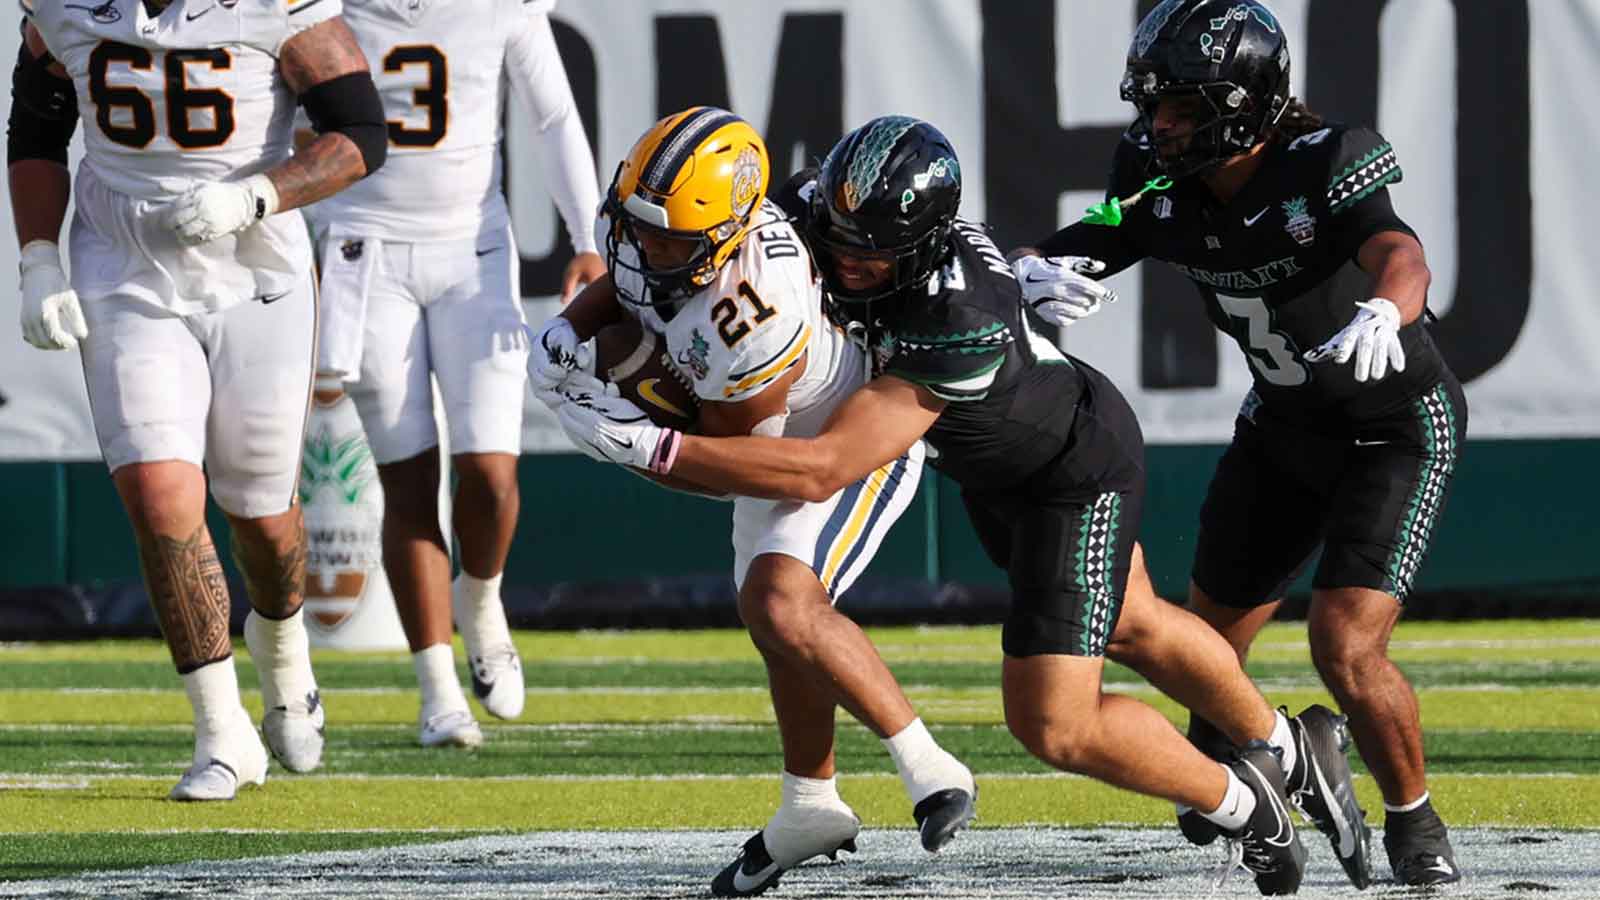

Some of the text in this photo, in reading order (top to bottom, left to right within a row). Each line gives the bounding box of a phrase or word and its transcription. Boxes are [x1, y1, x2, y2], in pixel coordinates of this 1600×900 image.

[88, 40, 235, 150] 66
[383, 44, 449, 148] 3
[710, 280, 777, 349] 21
[1215, 292, 1308, 387] 3
